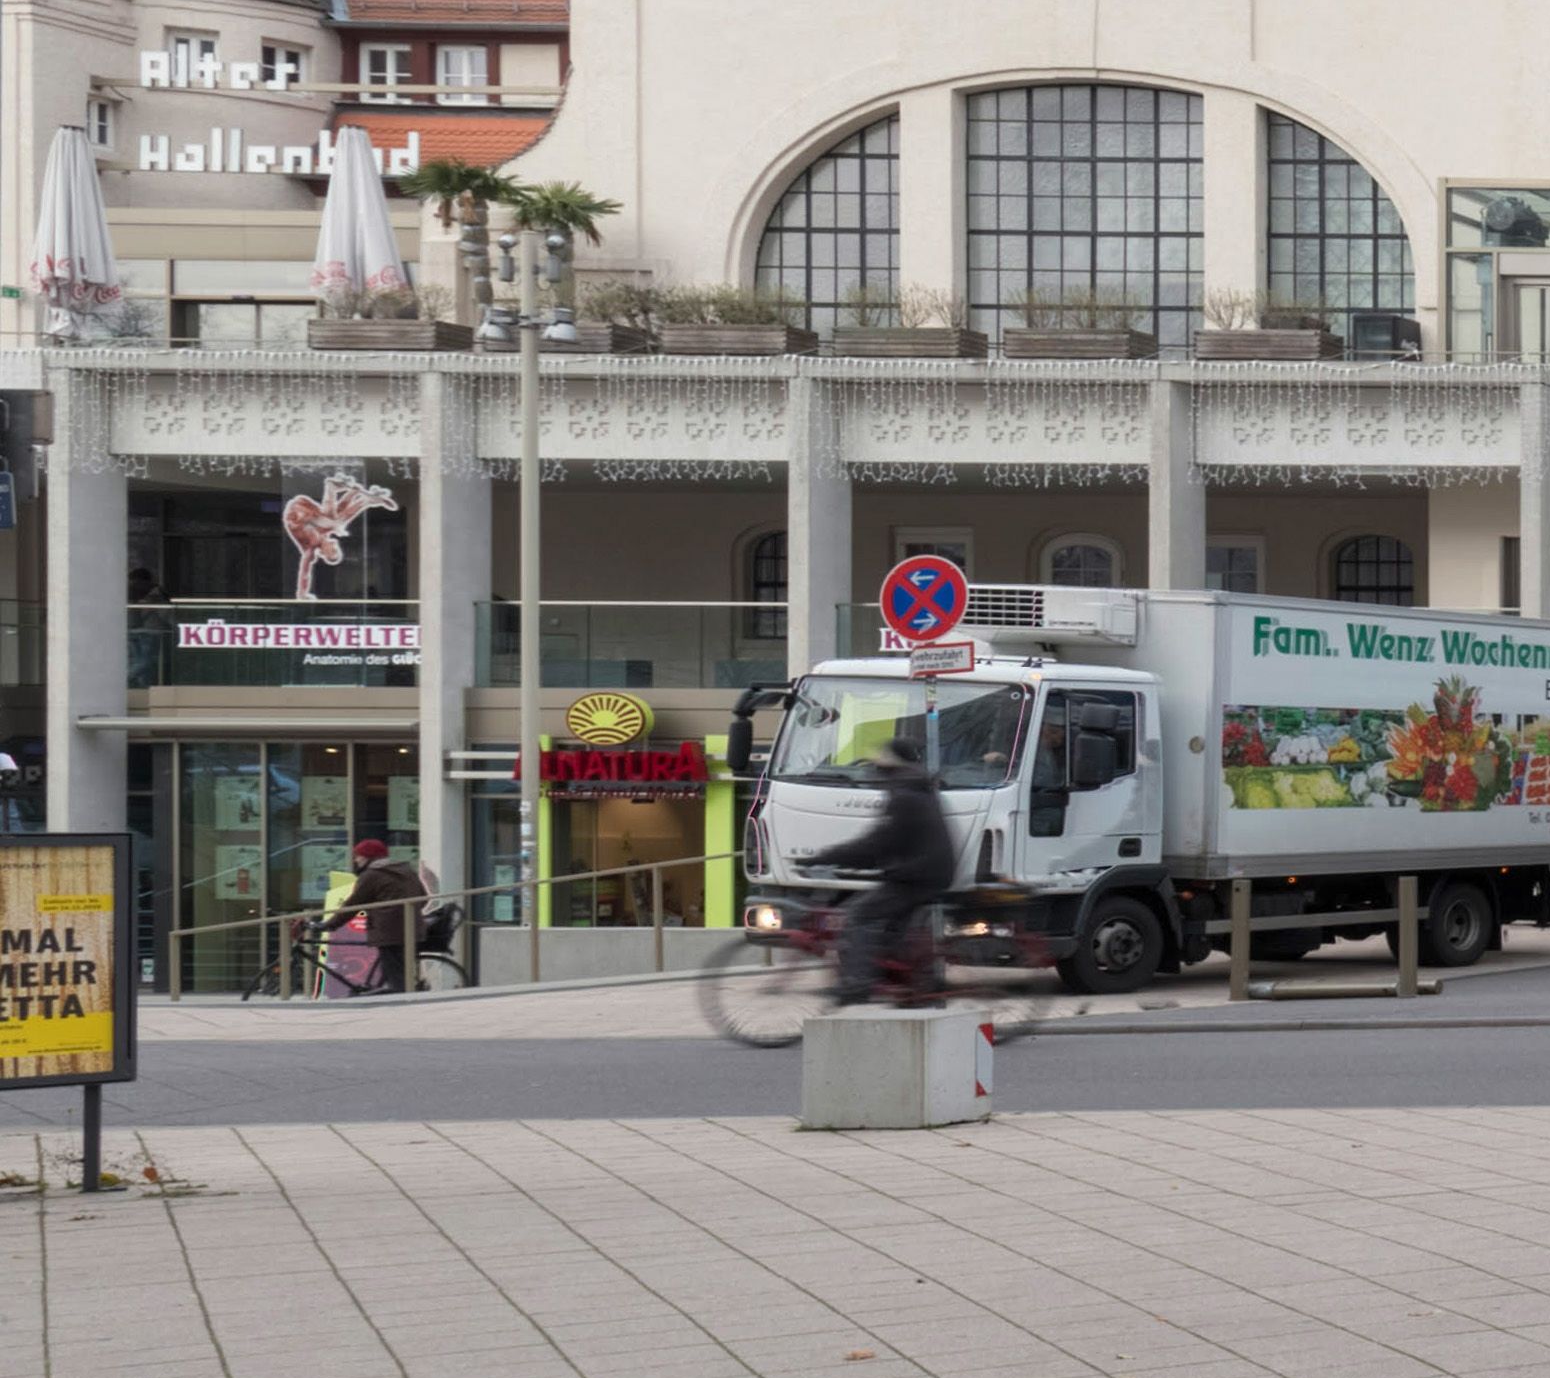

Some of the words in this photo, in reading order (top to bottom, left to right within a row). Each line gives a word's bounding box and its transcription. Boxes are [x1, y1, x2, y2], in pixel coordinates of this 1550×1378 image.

[139, 127, 420, 175] Hallenbd
[303, 653, 362, 665] Anatomie
[366, 653, 389, 665] des
[392, 652, 421, 665] GLÜC
[513, 741, 708, 782] LNATURA
[1, 927, 83, 954] MAL
